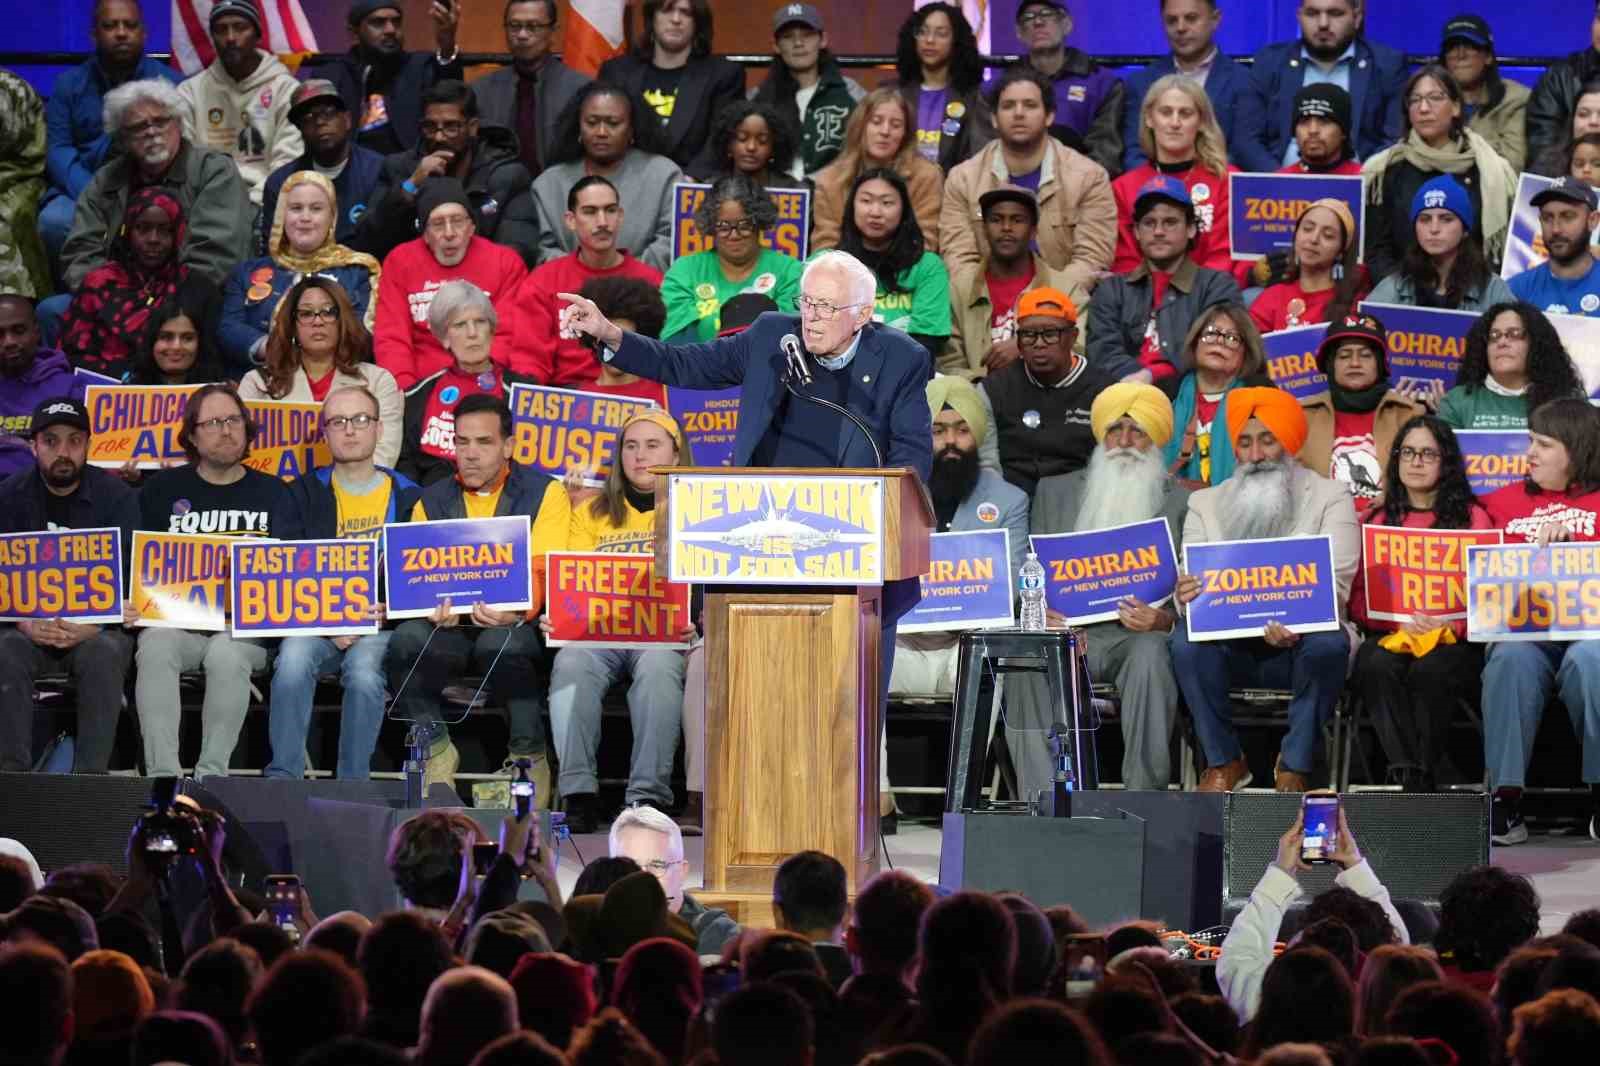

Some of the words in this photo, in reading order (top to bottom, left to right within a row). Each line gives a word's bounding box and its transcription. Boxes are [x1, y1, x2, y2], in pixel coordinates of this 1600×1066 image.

[771, 194, 800, 219] EE
[1385, 330, 1466, 358] OHRA
[516, 389, 576, 422] FAST
[683, 410, 738, 432] ZOH
[168, 509, 269, 534] EQUITY!
[676, 479, 765, 534] NEW
[766, 481, 877, 536] YORK
[60, 533, 114, 561] FREE
[239, 547, 297, 574] FAST
[316, 545, 370, 572] FREE
[402, 543, 513, 571] ZOHRAN
[677, 541, 733, 577] NOT
[739, 555, 797, 579] FOR
[803, 543, 880, 581] SALE
[424, 573, 450, 583] NEW
[453, 571, 481, 581] YORK
[483, 569, 509, 579] CITY
[1050, 545, 1161, 581] ZOHRAN
[1203, 562, 1319, 592] ZOHRAN
[1475, 550, 1533, 577] FAST
[931, 587, 961, 597] YORK
[963, 584, 989, 595] CITY
[1074, 582, 1099, 593] NEW
[1101, 576, 1131, 588] YORK
[1132, 571, 1158, 583] CITY
[240, 577, 369, 624] BUSES
[1226, 594, 1252, 604] NEW
[1255, 591, 1286, 602] YORK
[1287, 589, 1313, 600] CITY
[588, 597, 680, 636] RENT
